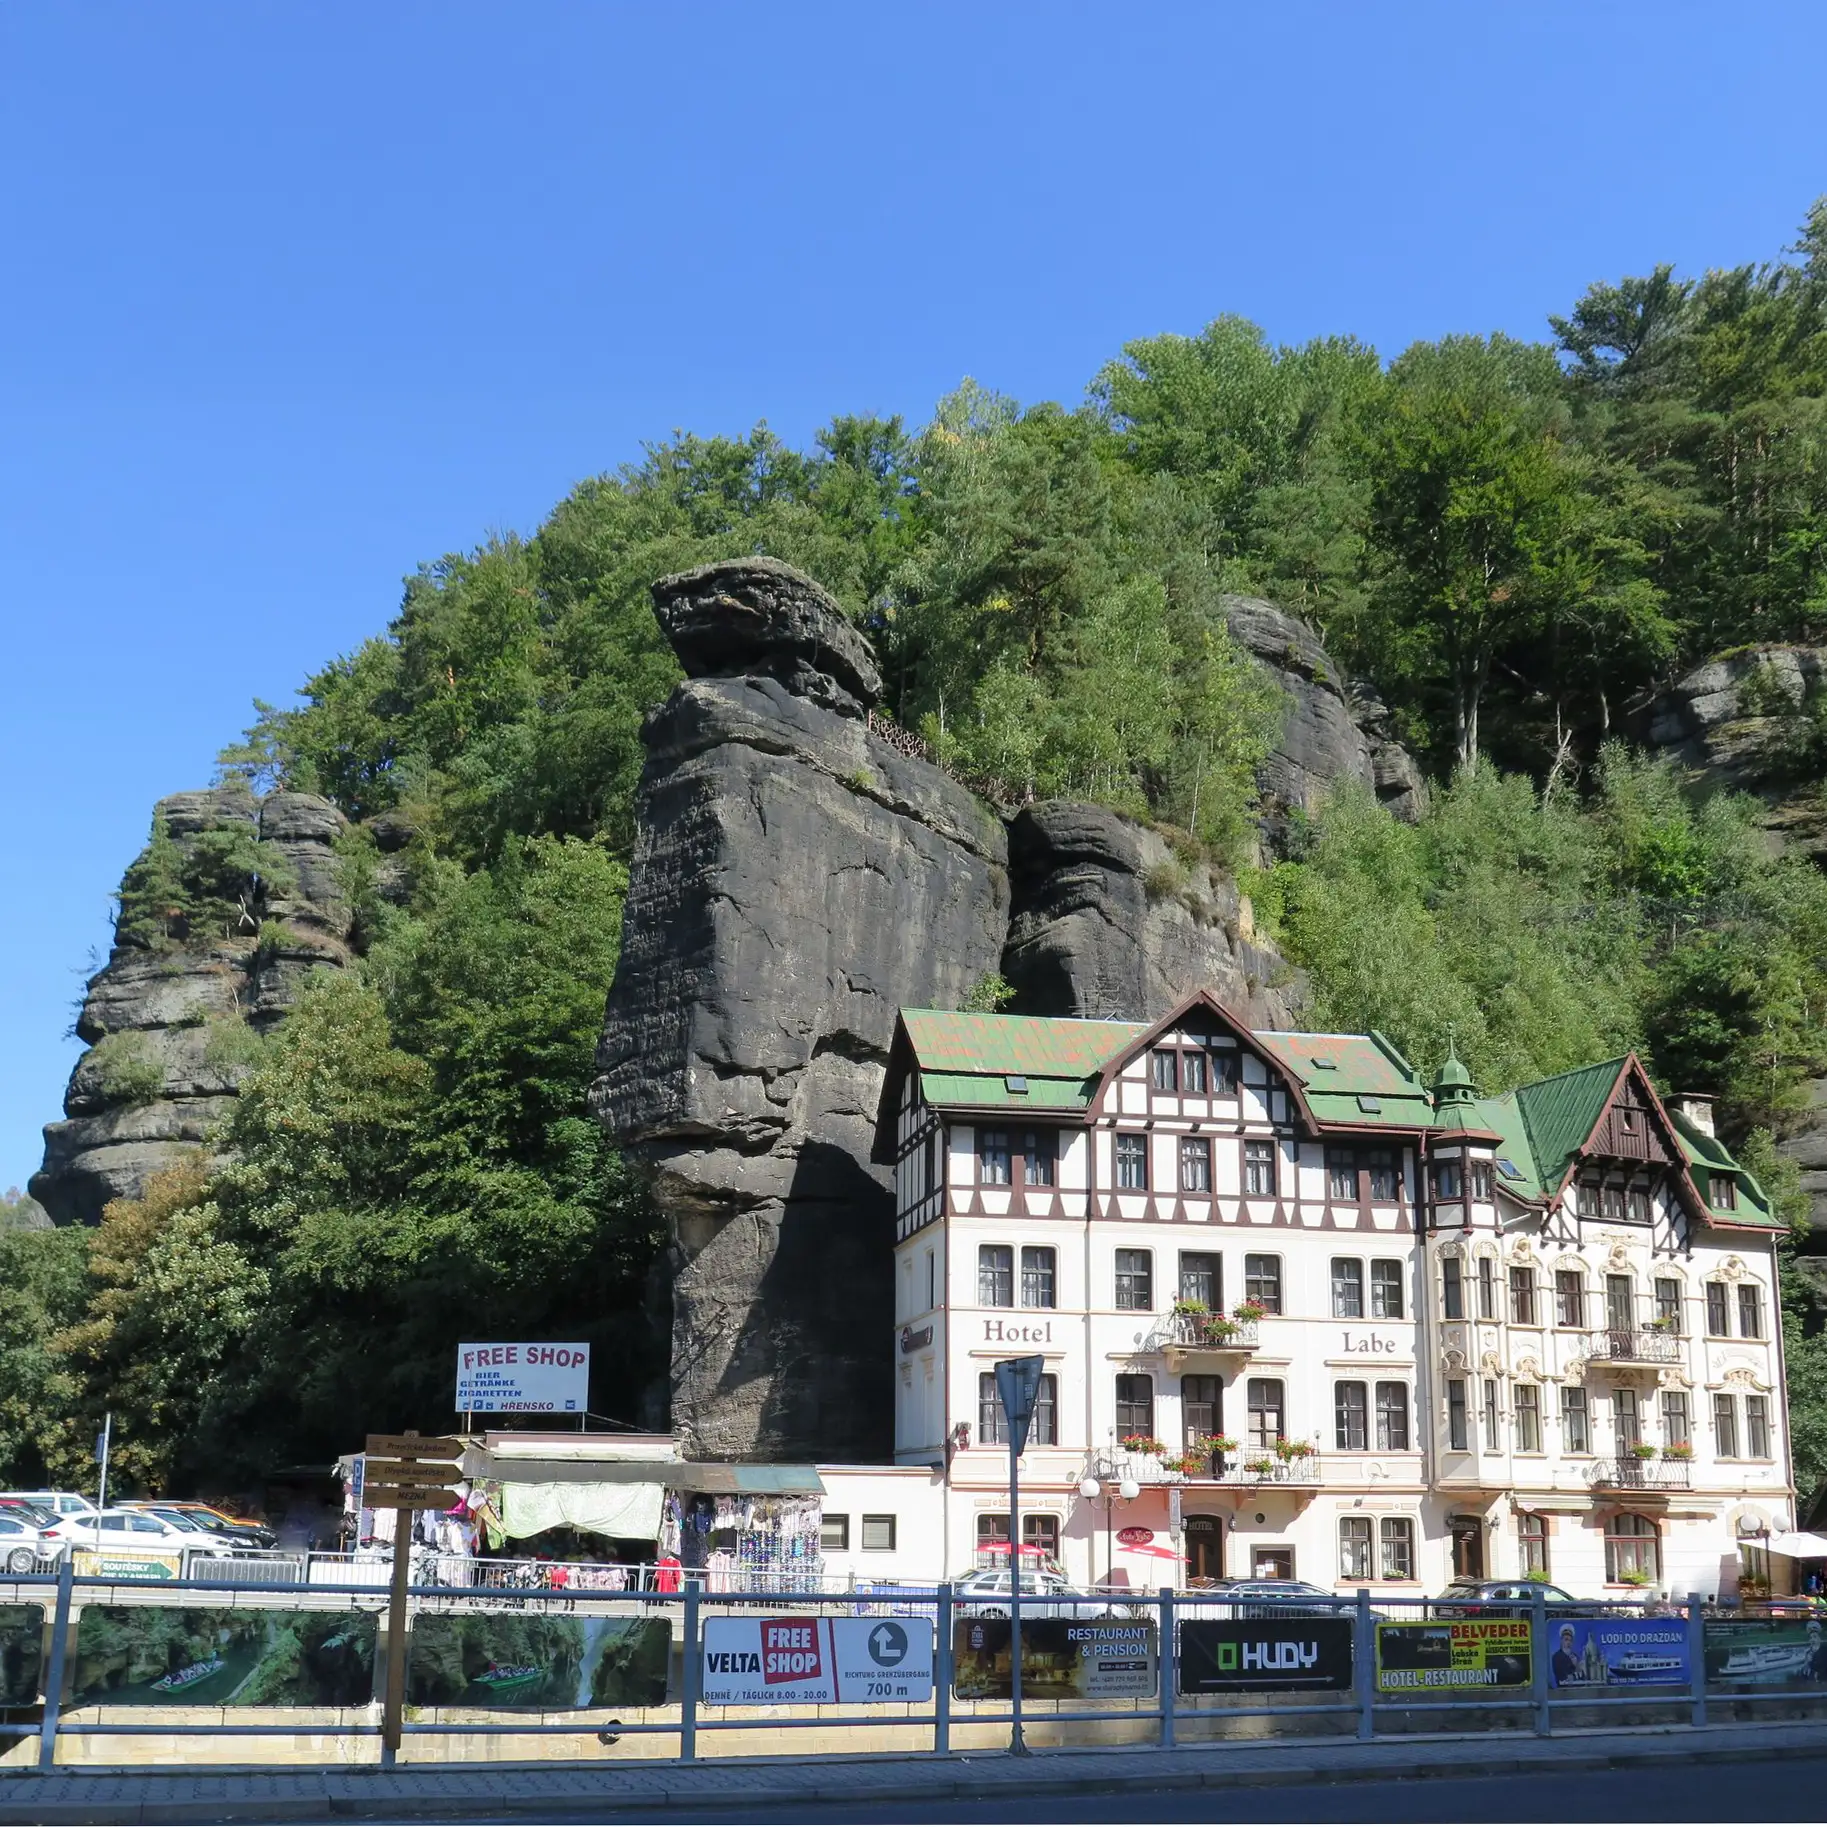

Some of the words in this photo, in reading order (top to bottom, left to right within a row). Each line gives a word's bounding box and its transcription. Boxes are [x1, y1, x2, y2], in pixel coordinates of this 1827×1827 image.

[983, 1320, 1052, 1342] Hotel
[1342, 1332, 1396, 1353] Labe
[464, 1347, 518, 1370] FREE
[526, 1347, 585, 1369] SHOP
[460, 1379, 516, 1388] GETRÄNKE
[768, 1628, 811, 1648] FREE
[1068, 1628, 1148, 1640] RESTAURANT
[1451, 1624, 1528, 1638] BELVEDER
[1625, 1633, 1637, 1643] DO
[1082, 1645, 1091, 1656] &
[1095, 1644, 1148, 1656] PENSION
[1242, 1642, 1318, 1669] HUDY
[707, 1653, 760, 1673] VELTA
[767, 1653, 817, 1674] SHOP
[1381, 1668, 1498, 1687] HOTEL-RESTAURANT
[705, 1689, 731, 1699] DENNĚ
[742, 1689, 774, 1699] TÄGLICH
[777, 1691, 795, 1699] 8.00
[804, 1691, 827, 1699] 20.00
[867, 1683, 892, 1696] 700
[897, 1686, 908, 1695] m
